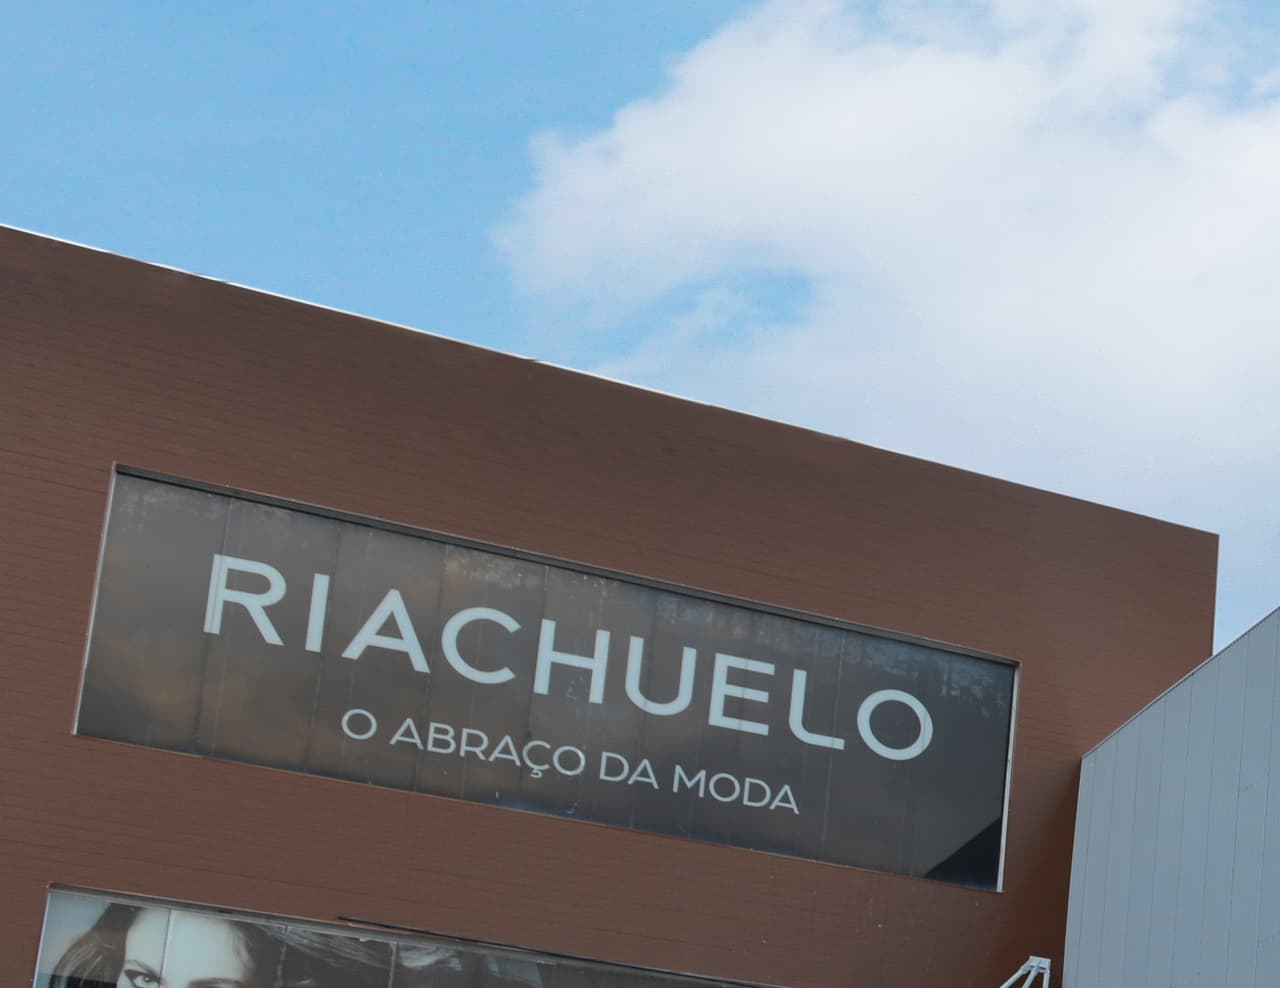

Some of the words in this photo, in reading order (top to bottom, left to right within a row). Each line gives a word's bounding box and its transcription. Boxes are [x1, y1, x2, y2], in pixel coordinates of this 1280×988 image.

[202, 553, 934, 762] RIACHUELO
[340, 708, 378, 741] O
[388, 717, 587, 779] ABRAÇO
[599, 751, 660, 791] DA
[673, 767, 800, 816] MODA
